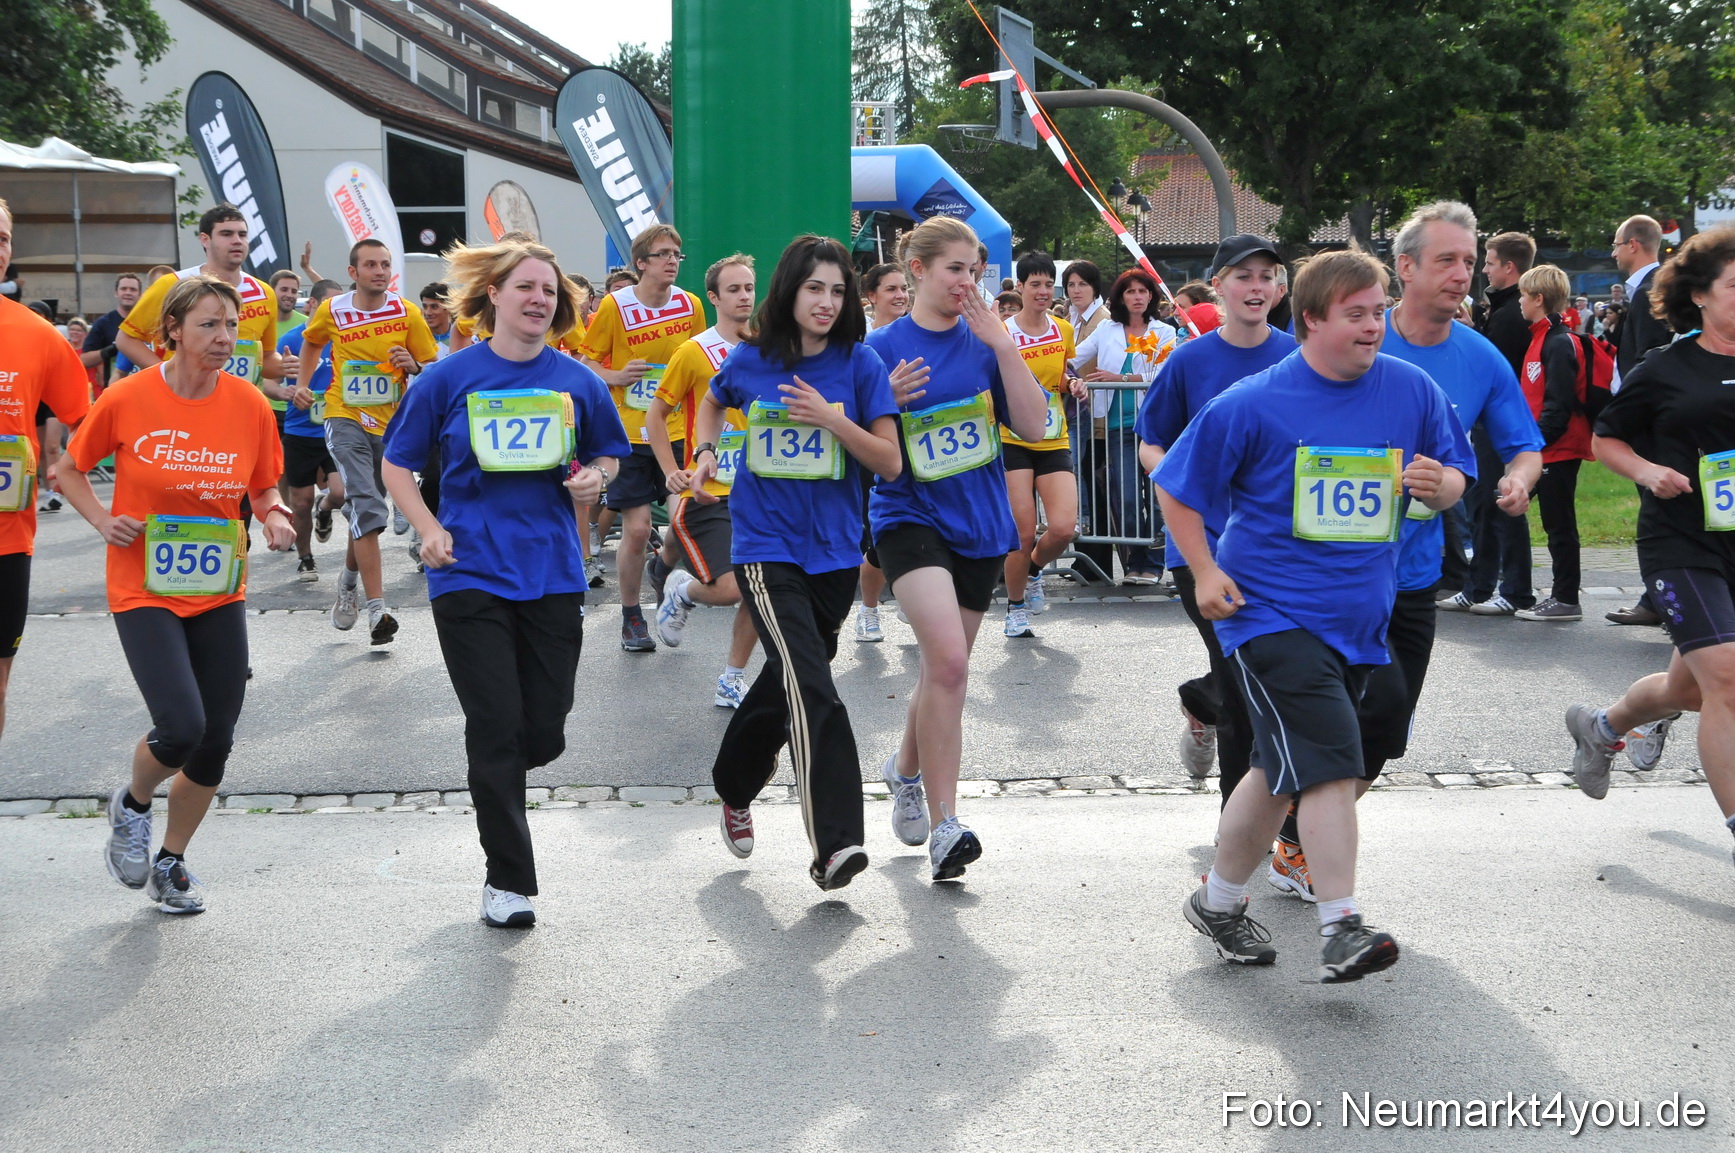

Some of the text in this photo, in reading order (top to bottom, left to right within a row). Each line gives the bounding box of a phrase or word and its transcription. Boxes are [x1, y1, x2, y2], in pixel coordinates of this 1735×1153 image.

[340, 322, 409, 344] MAX BÖGL
[627, 321, 692, 346] MAX BÖGL
[1042, 345, 1065, 356] BÖGL
[224, 357, 249, 377] 28
[347, 376, 389, 395] 410
[631, 380, 657, 398] 45
[483, 417, 551, 450] 127
[759, 428, 824, 459] 134
[918, 421, 980, 461] 133
[153, 444, 238, 465] Fischer
[499, 451, 524, 460] Sylvia
[718, 451, 741, 472] 46
[923, 456, 959, 471] Katharina
[0, 462, 12, 491] 5
[161, 463, 232, 474] AUTOMOBILE
[176, 481, 195, 490] und
[197, 480, 215, 489] das
[199, 491, 225, 501] fährt
[1309, 480, 1382, 517] 165
[1715, 480, 1735, 511] 5
[1317, 518, 1352, 527] Michael
[155, 543, 222, 576] 956
[166, 576, 187, 585] Katja
